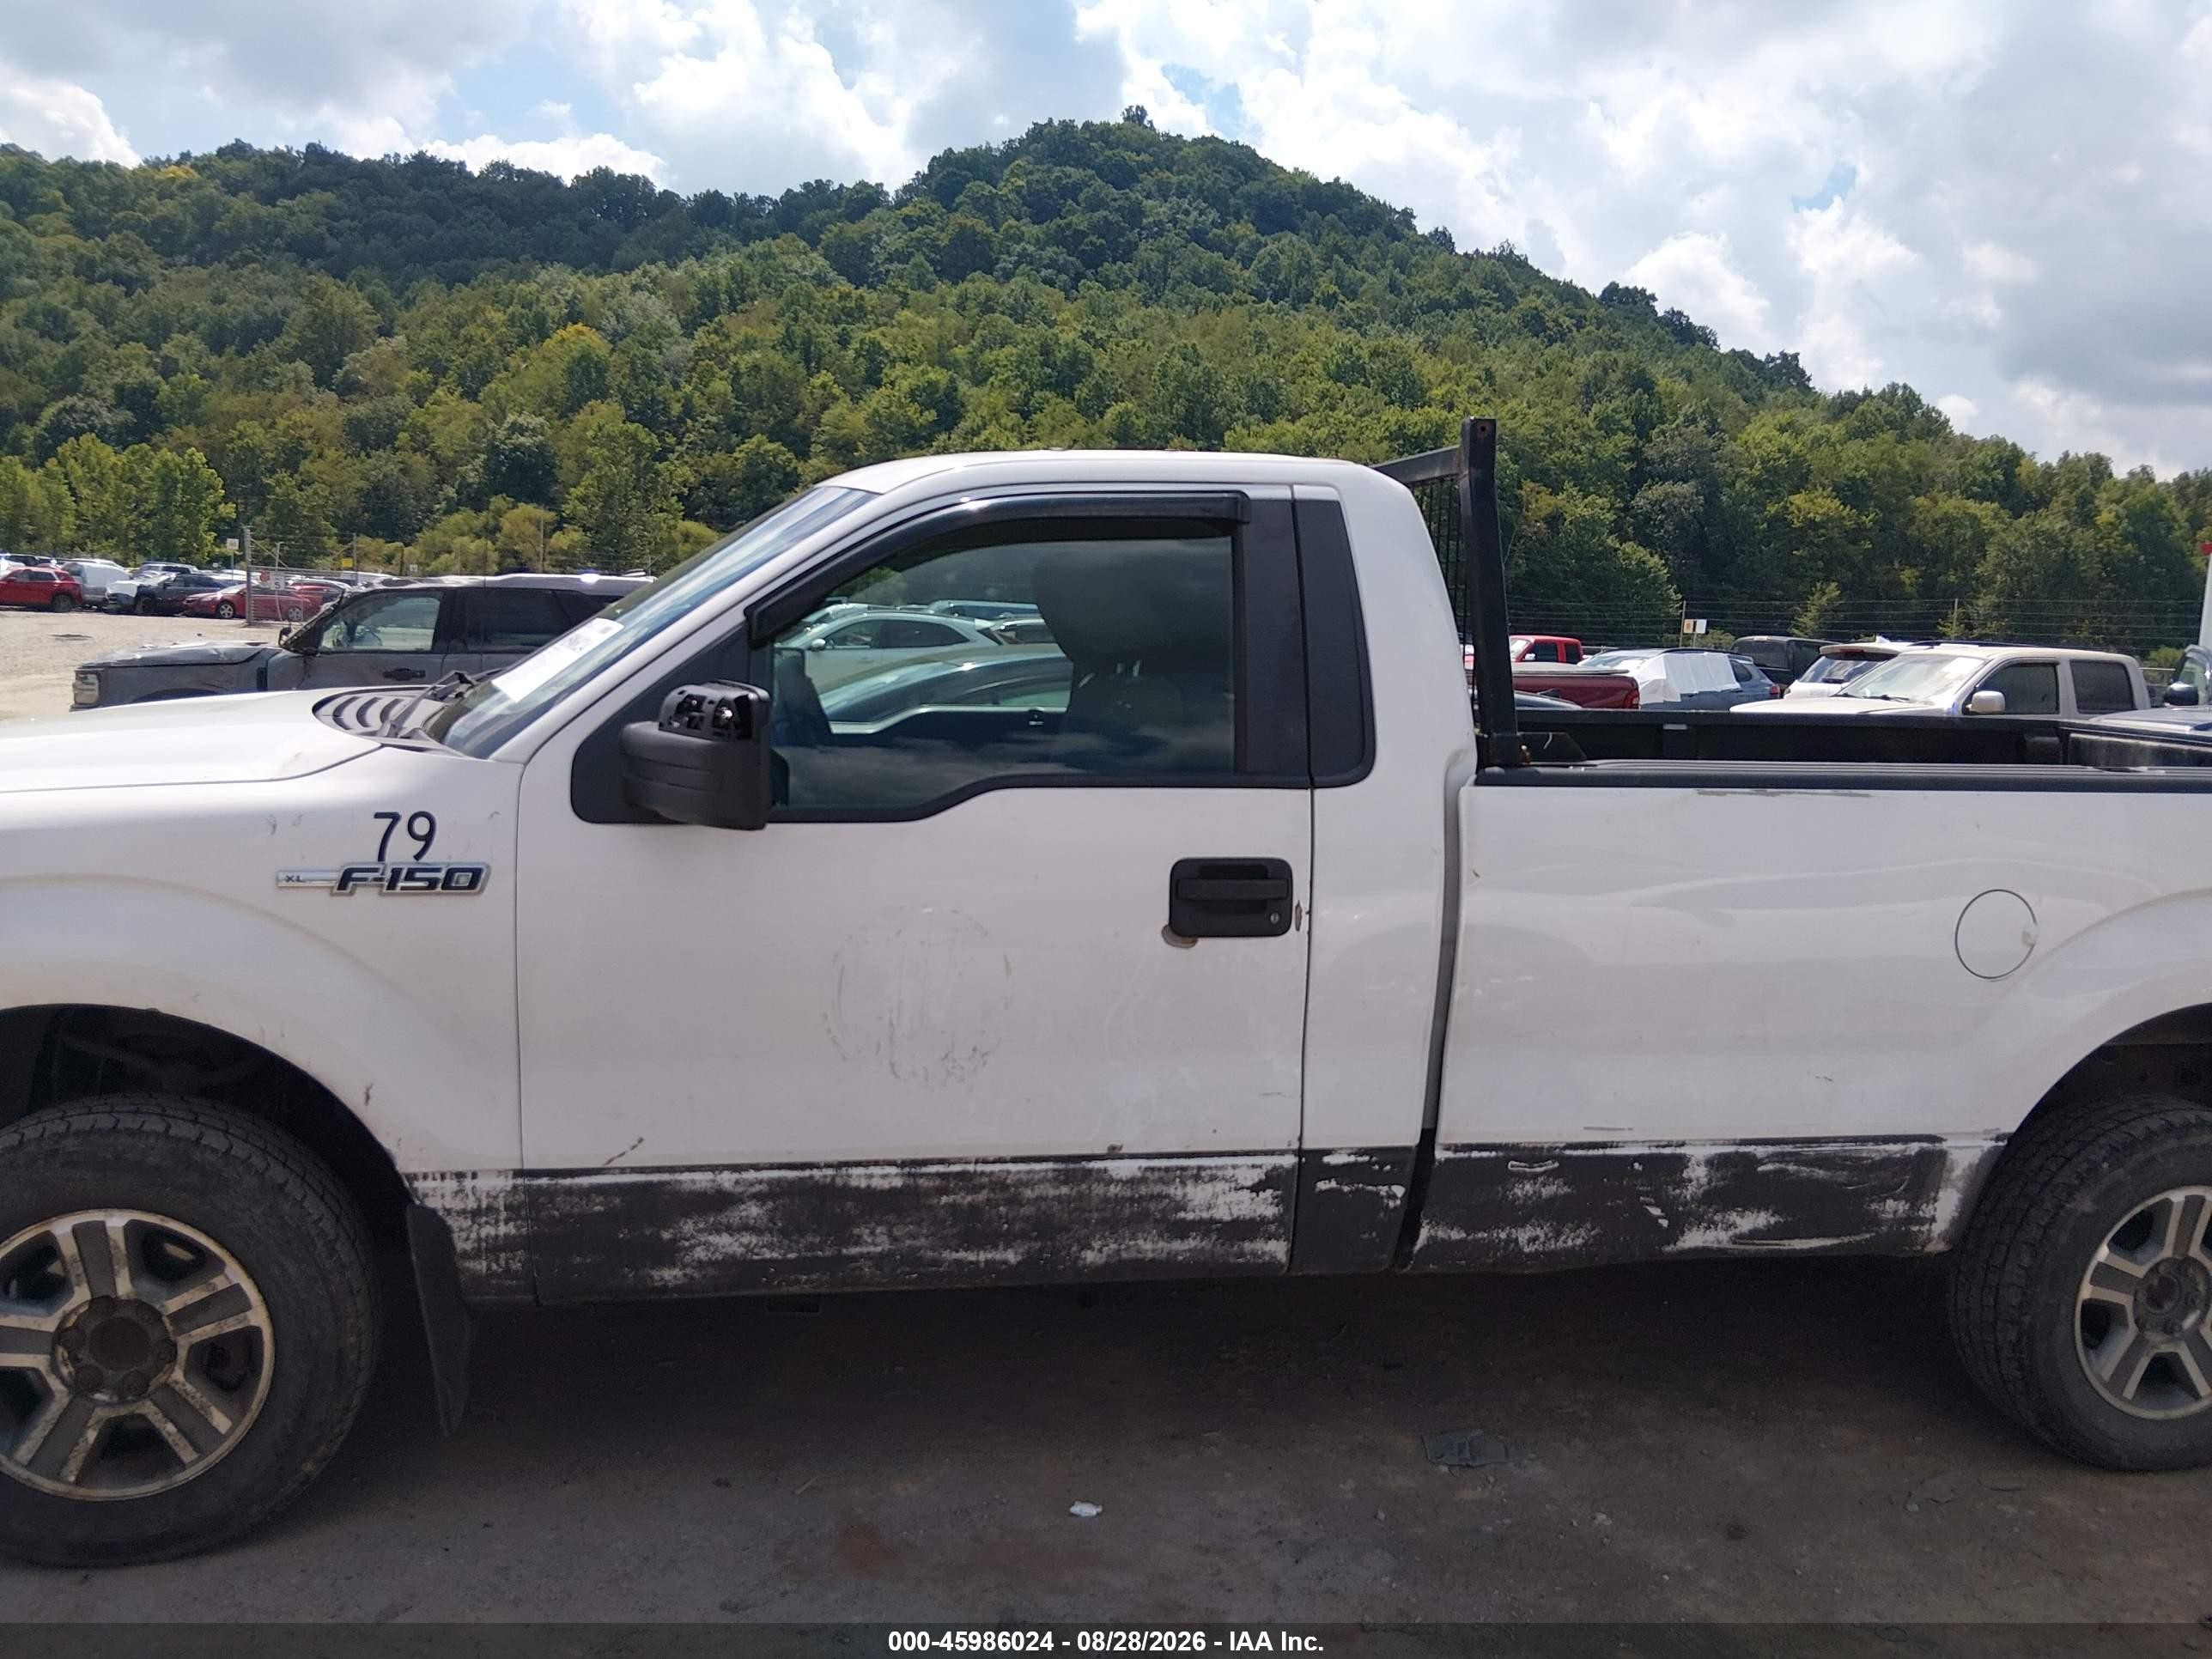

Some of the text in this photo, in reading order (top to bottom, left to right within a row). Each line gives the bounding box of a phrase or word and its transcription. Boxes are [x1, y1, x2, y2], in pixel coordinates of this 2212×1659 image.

[374, 811, 437, 862] 79
[285, 866, 486, 891] XL F-150
